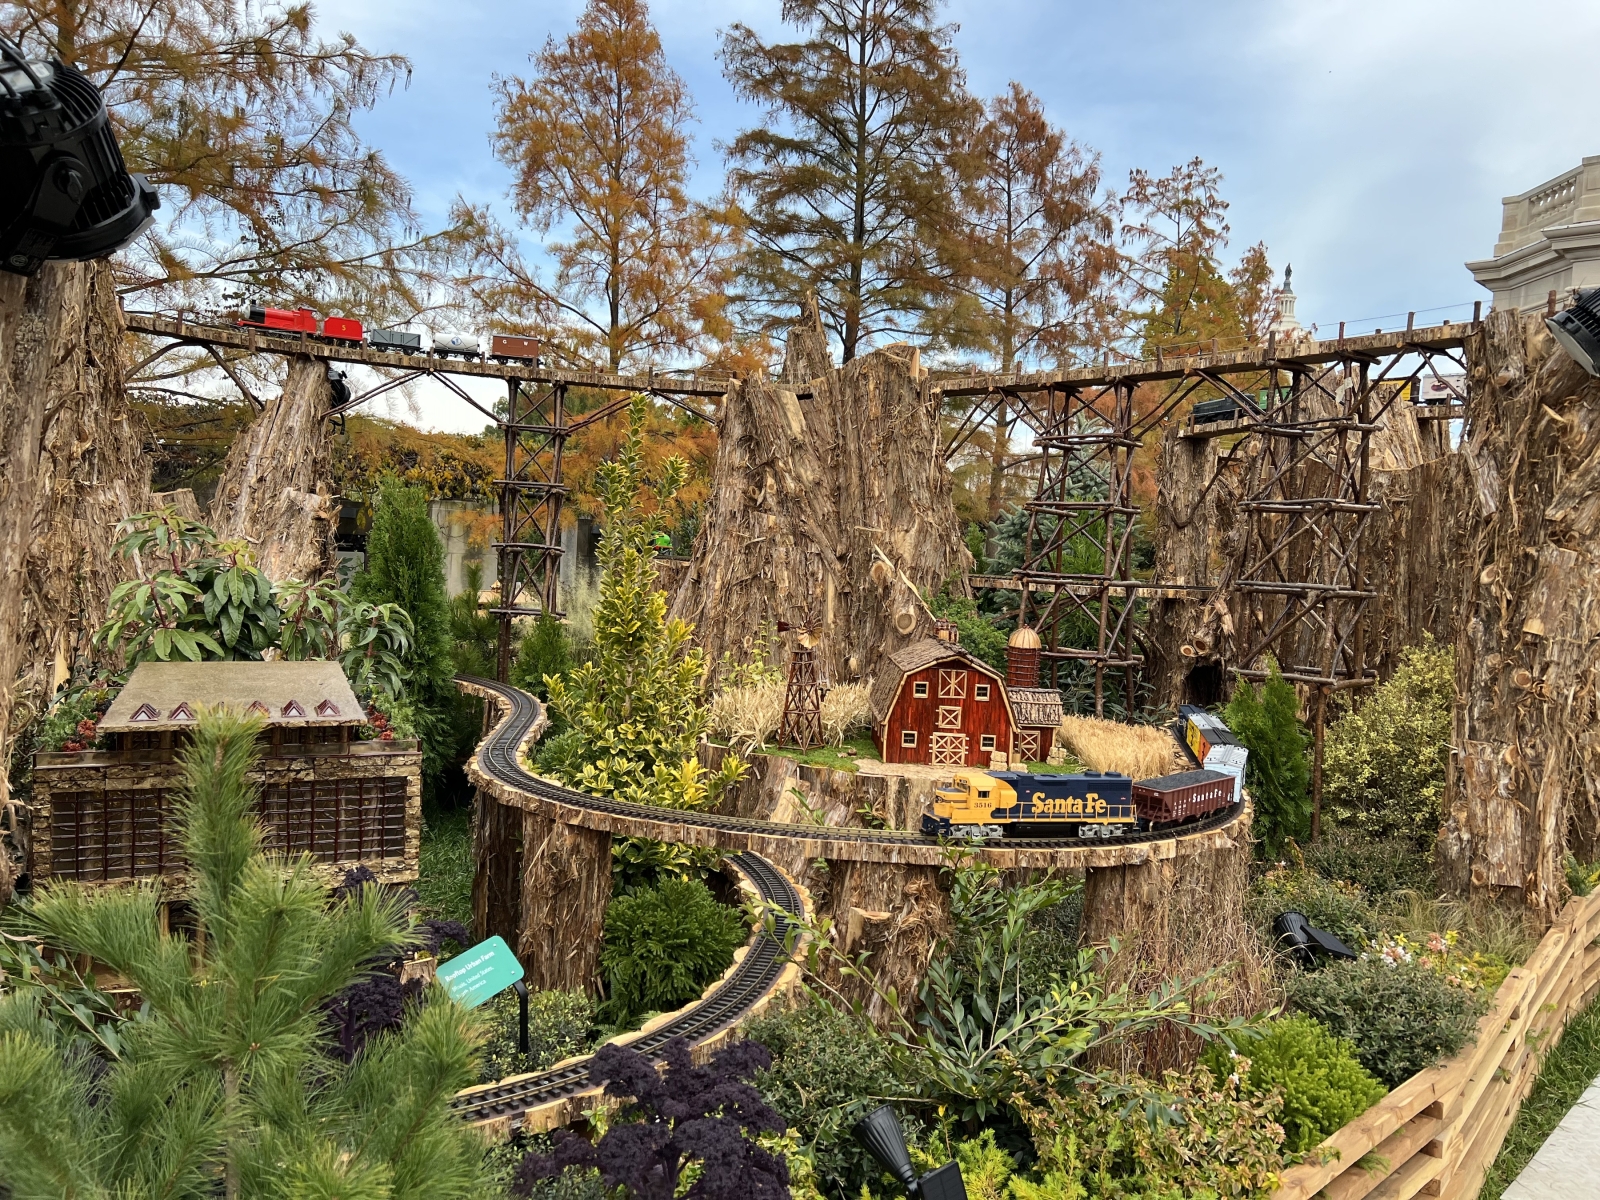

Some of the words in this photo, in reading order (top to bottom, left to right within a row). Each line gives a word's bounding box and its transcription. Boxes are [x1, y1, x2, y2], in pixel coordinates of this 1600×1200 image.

[1031, 792, 1082, 814] Santa
[1085, 793, 1107, 813] Fe
[1192, 792, 1213, 803] Santa
[1213, 788, 1222, 798] Fe
[444, 967, 467, 982] Rooftop
[465, 958, 482, 970] Urban
[480, 951, 495, 962] Farm
[466, 973, 481, 984] United
[469, 979, 487, 993] America
